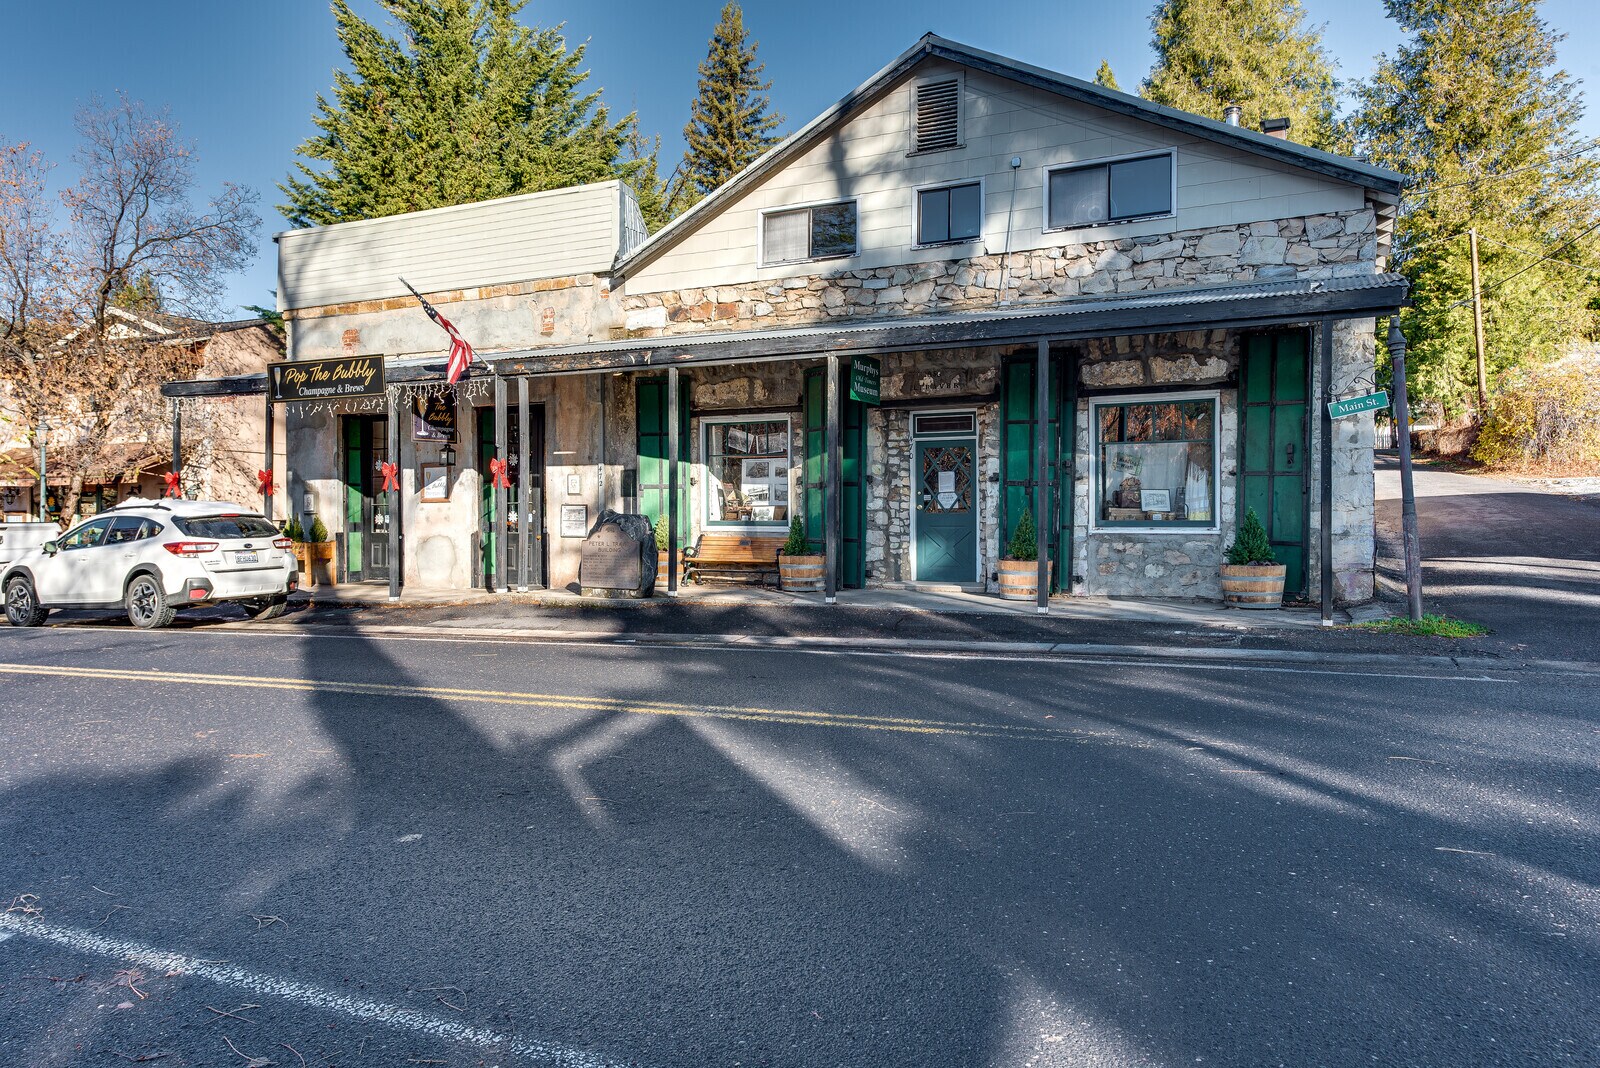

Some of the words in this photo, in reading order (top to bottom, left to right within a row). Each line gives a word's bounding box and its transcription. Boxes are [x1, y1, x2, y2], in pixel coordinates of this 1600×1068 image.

[285, 368, 308, 389] Pop
[310, 363, 331, 383] The
[332, 360, 376, 386] Bubbly
[853, 360, 879, 377] Murphys
[299, 386, 336, 396] Champagne
[336, 384, 343, 393] &
[345, 383, 365, 393] Brews
[853, 382, 879, 396] Museum
[435, 402, 447, 410] The
[1338, 402, 1364, 412] Main
[1366, 398, 1379, 407] St.
[428, 412, 453, 426] Bubbly
